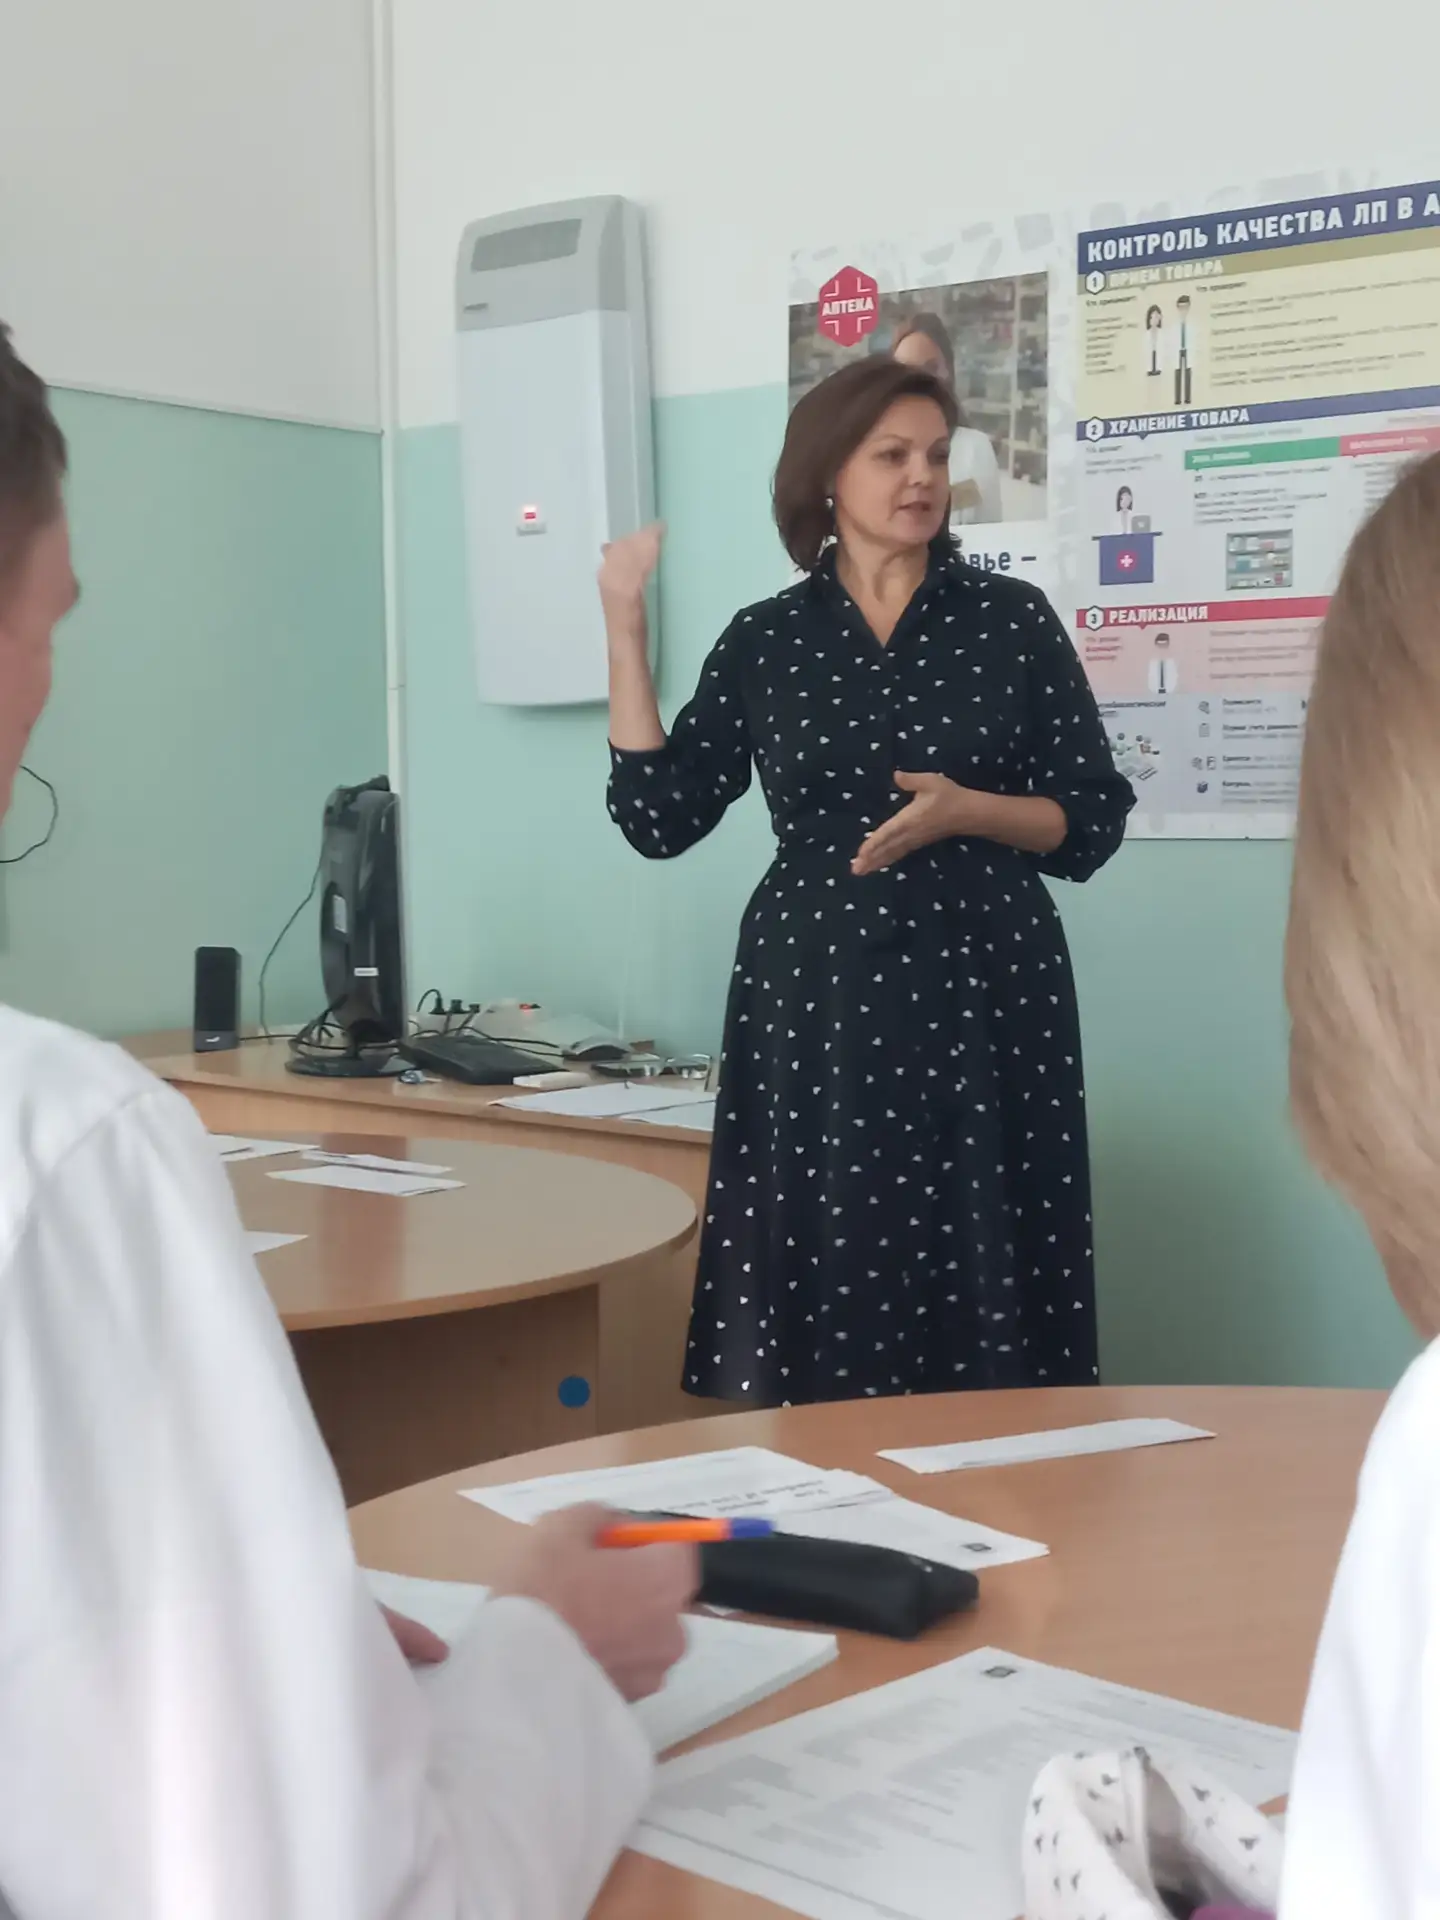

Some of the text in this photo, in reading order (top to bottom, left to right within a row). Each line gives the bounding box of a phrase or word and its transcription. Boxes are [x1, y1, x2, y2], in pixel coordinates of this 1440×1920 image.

[1087, 227, 1208, 263] КОНТРОЛЬ
[1216, 206, 1343, 245] КАЧЕСТВА
[1352, 200, 1388, 226] ЛП
[1397, 196, 1413, 220] В
[1165, 259, 1223, 281] ТОВАРА
[822, 296, 875, 317] АПТЕКА
[1109, 413, 1187, 435] ХРАНЕНИЕ
[1190, 408, 1250, 427] ТОВАРА
[961, 551, 1011, 573] вье
[1108, 605, 1208, 624] РЕАЛИЗАЦИЯ
